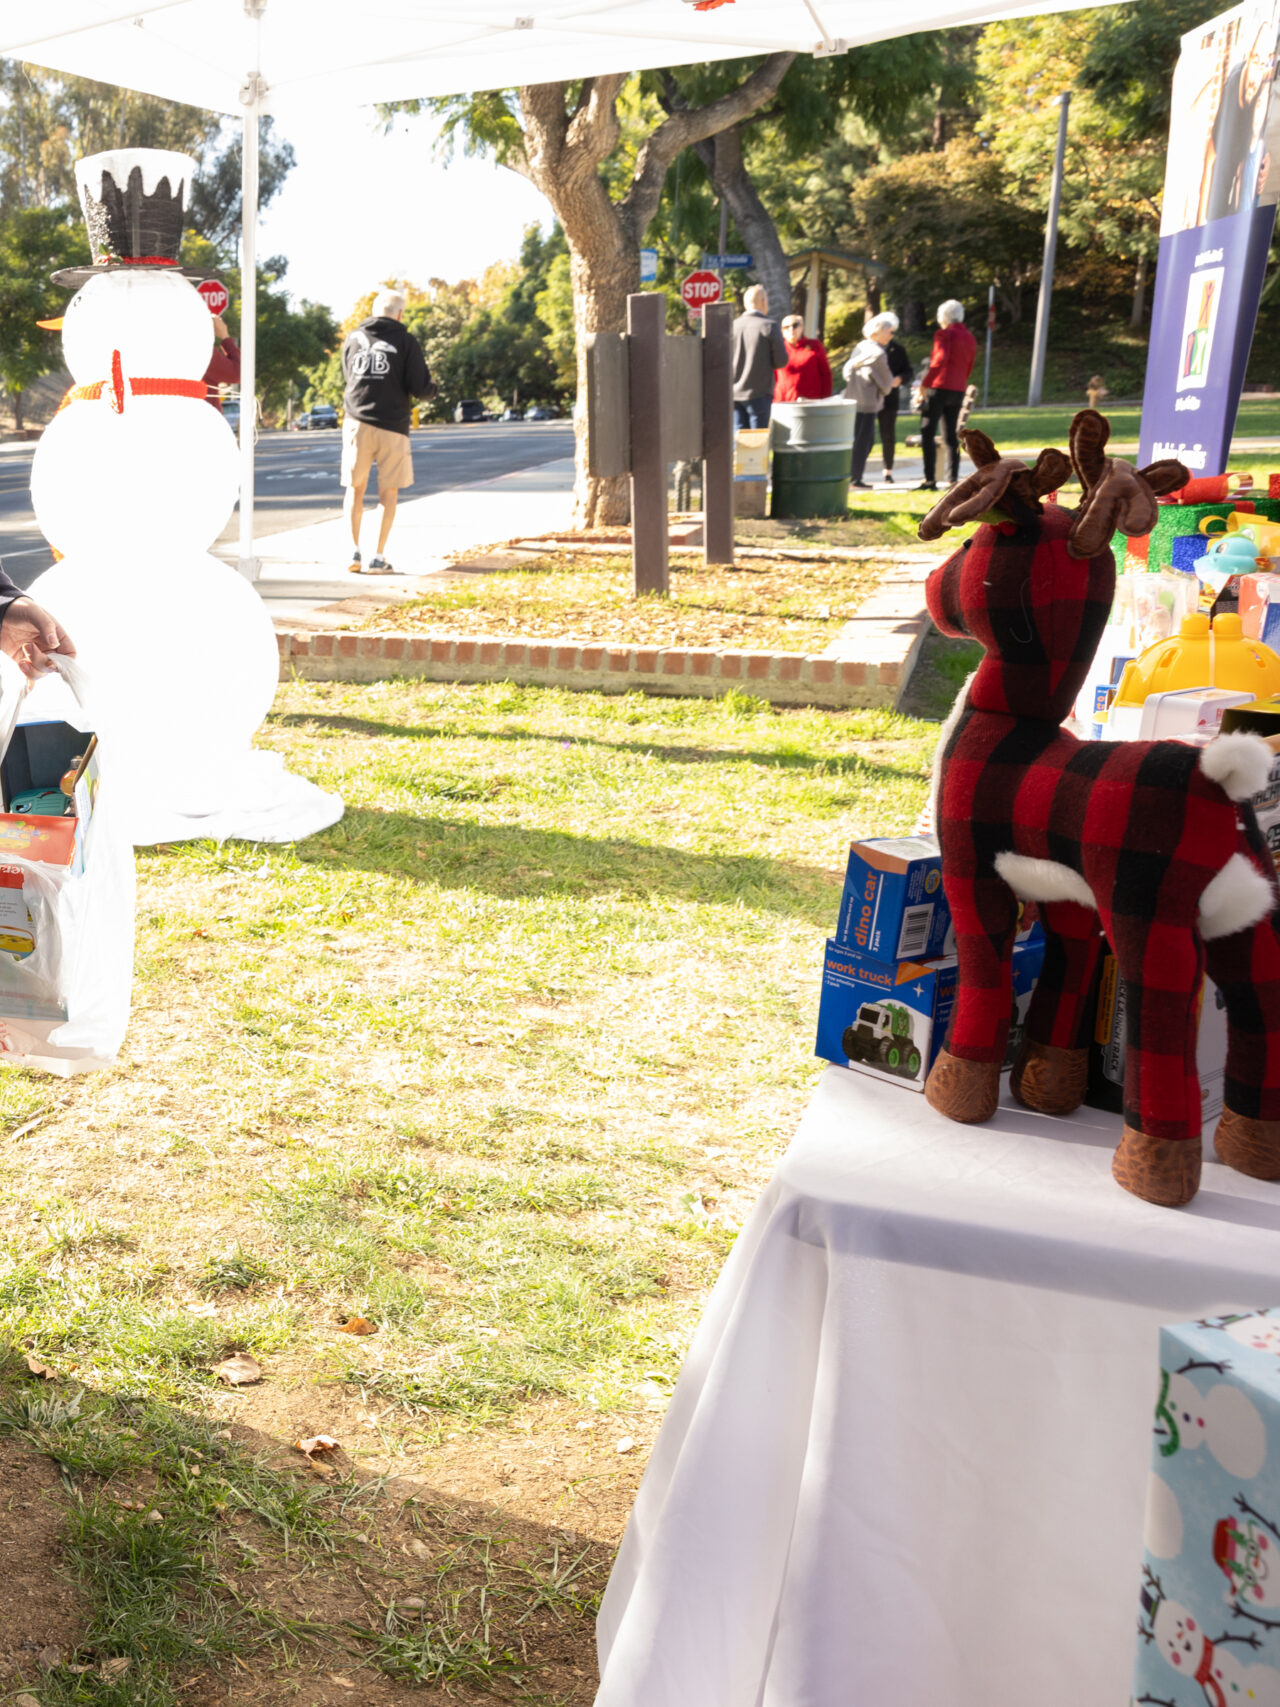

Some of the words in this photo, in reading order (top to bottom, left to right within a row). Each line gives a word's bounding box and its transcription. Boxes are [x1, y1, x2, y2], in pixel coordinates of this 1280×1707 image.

[202, 291, 226, 307] TOP
[684, 281, 719, 298] STOP
[854, 905, 872, 946] dino
[864, 871, 877, 901] car
[873, 930, 881, 947] pack
[826, 959, 857, 976] work
[858, 967, 892, 987] truck
[1114, 1000, 1124, 1040] LAUNCH
[1110, 1041, 1120, 1072] TRACK
